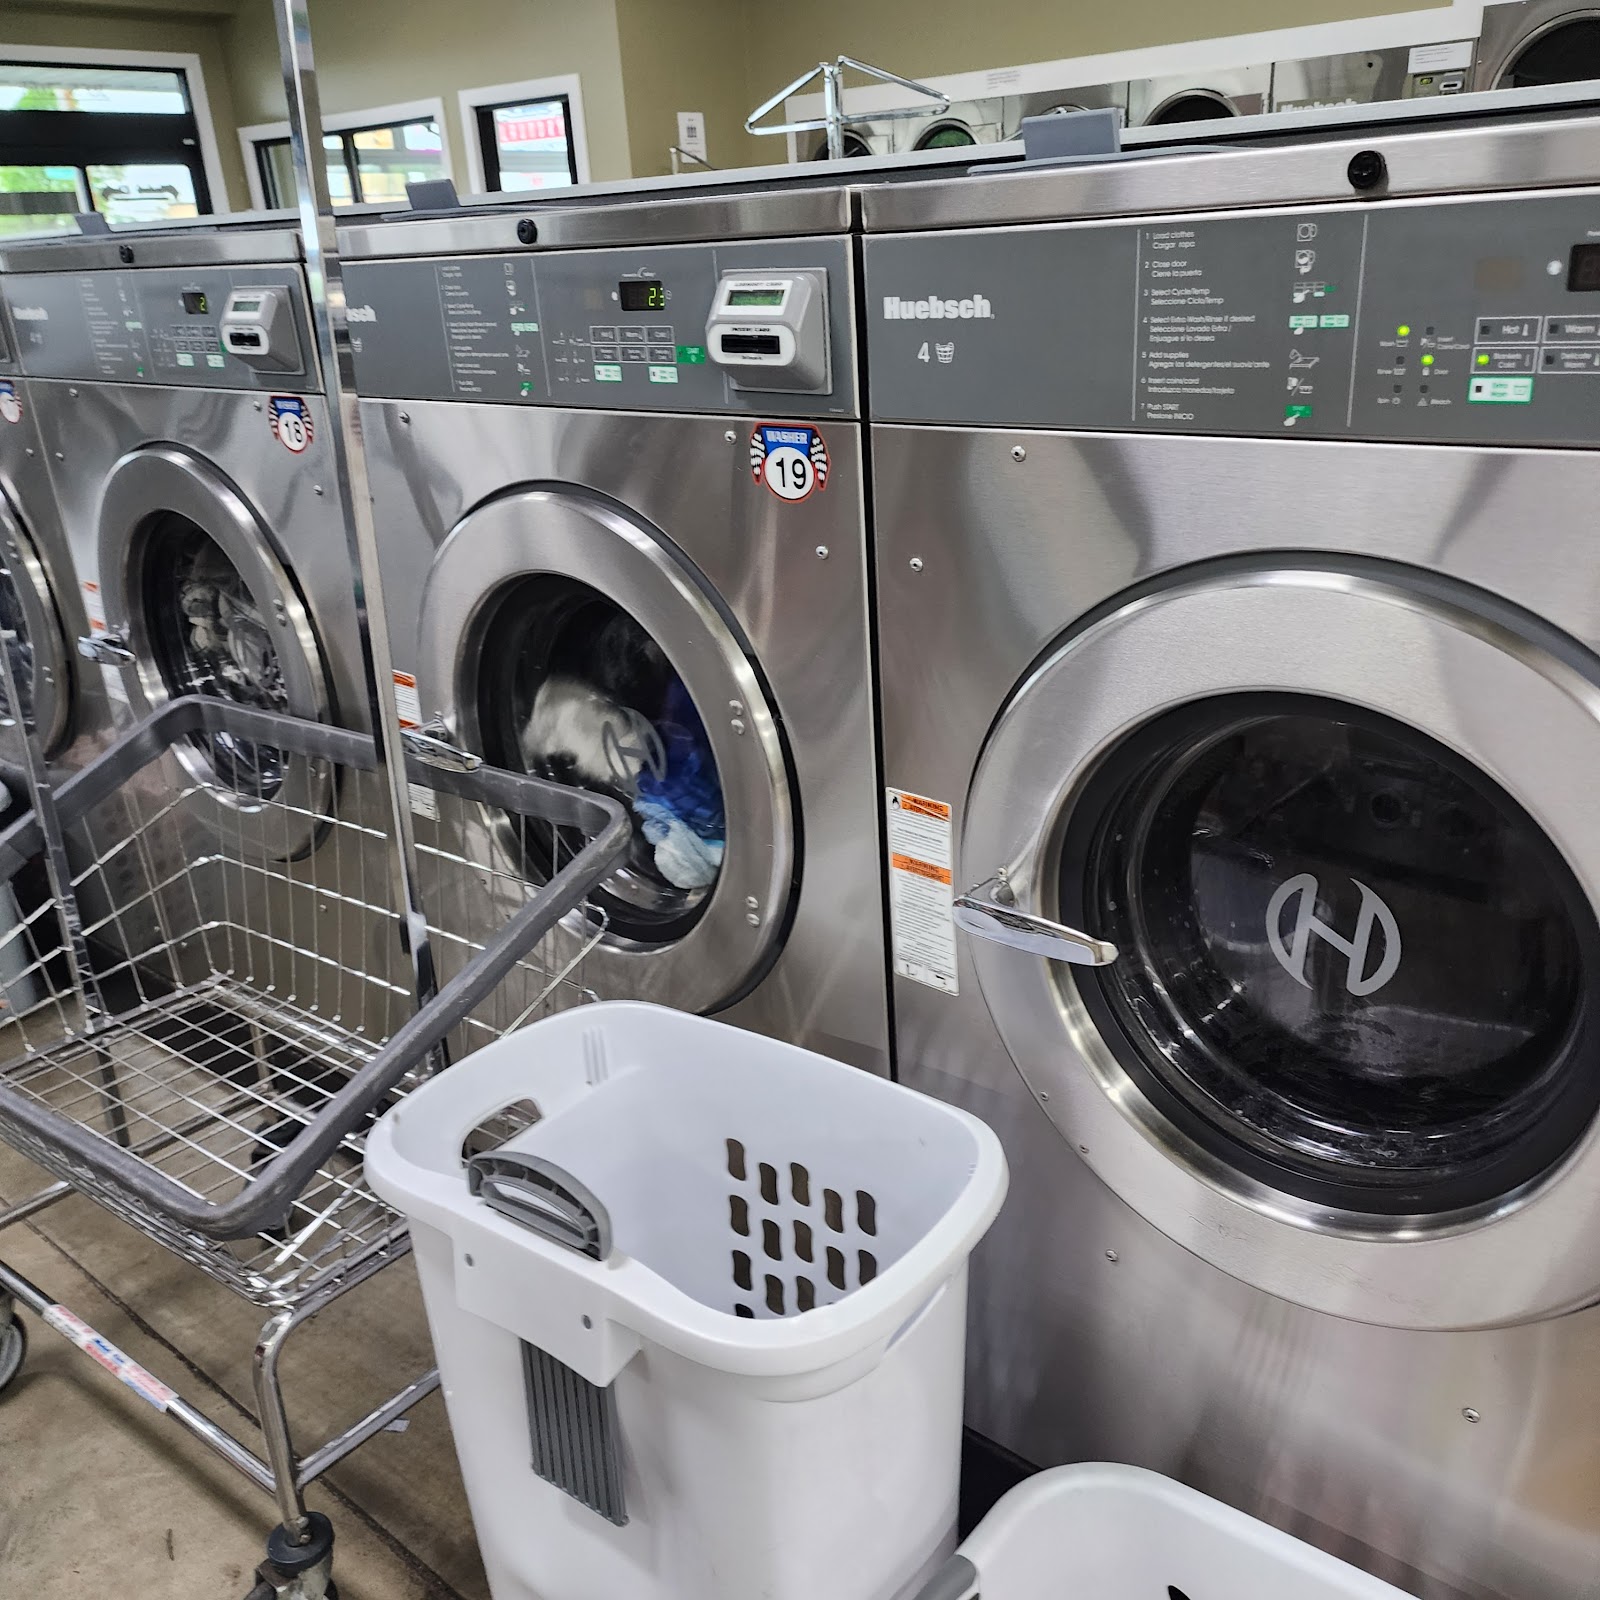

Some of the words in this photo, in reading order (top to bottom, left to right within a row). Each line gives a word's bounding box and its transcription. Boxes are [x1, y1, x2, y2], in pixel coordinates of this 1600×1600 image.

[1144, 261, 1150, 269] 2
[1171, 260, 1188, 268] door
[883, 294, 991, 319] Huebsch
[1150, 298, 1186, 306] Seleccione
[1150, 325, 1185, 333] Seleccione
[917, 342, 930, 363] 4
[284, 420, 303, 443] 18
[775, 457, 806, 490] 19
